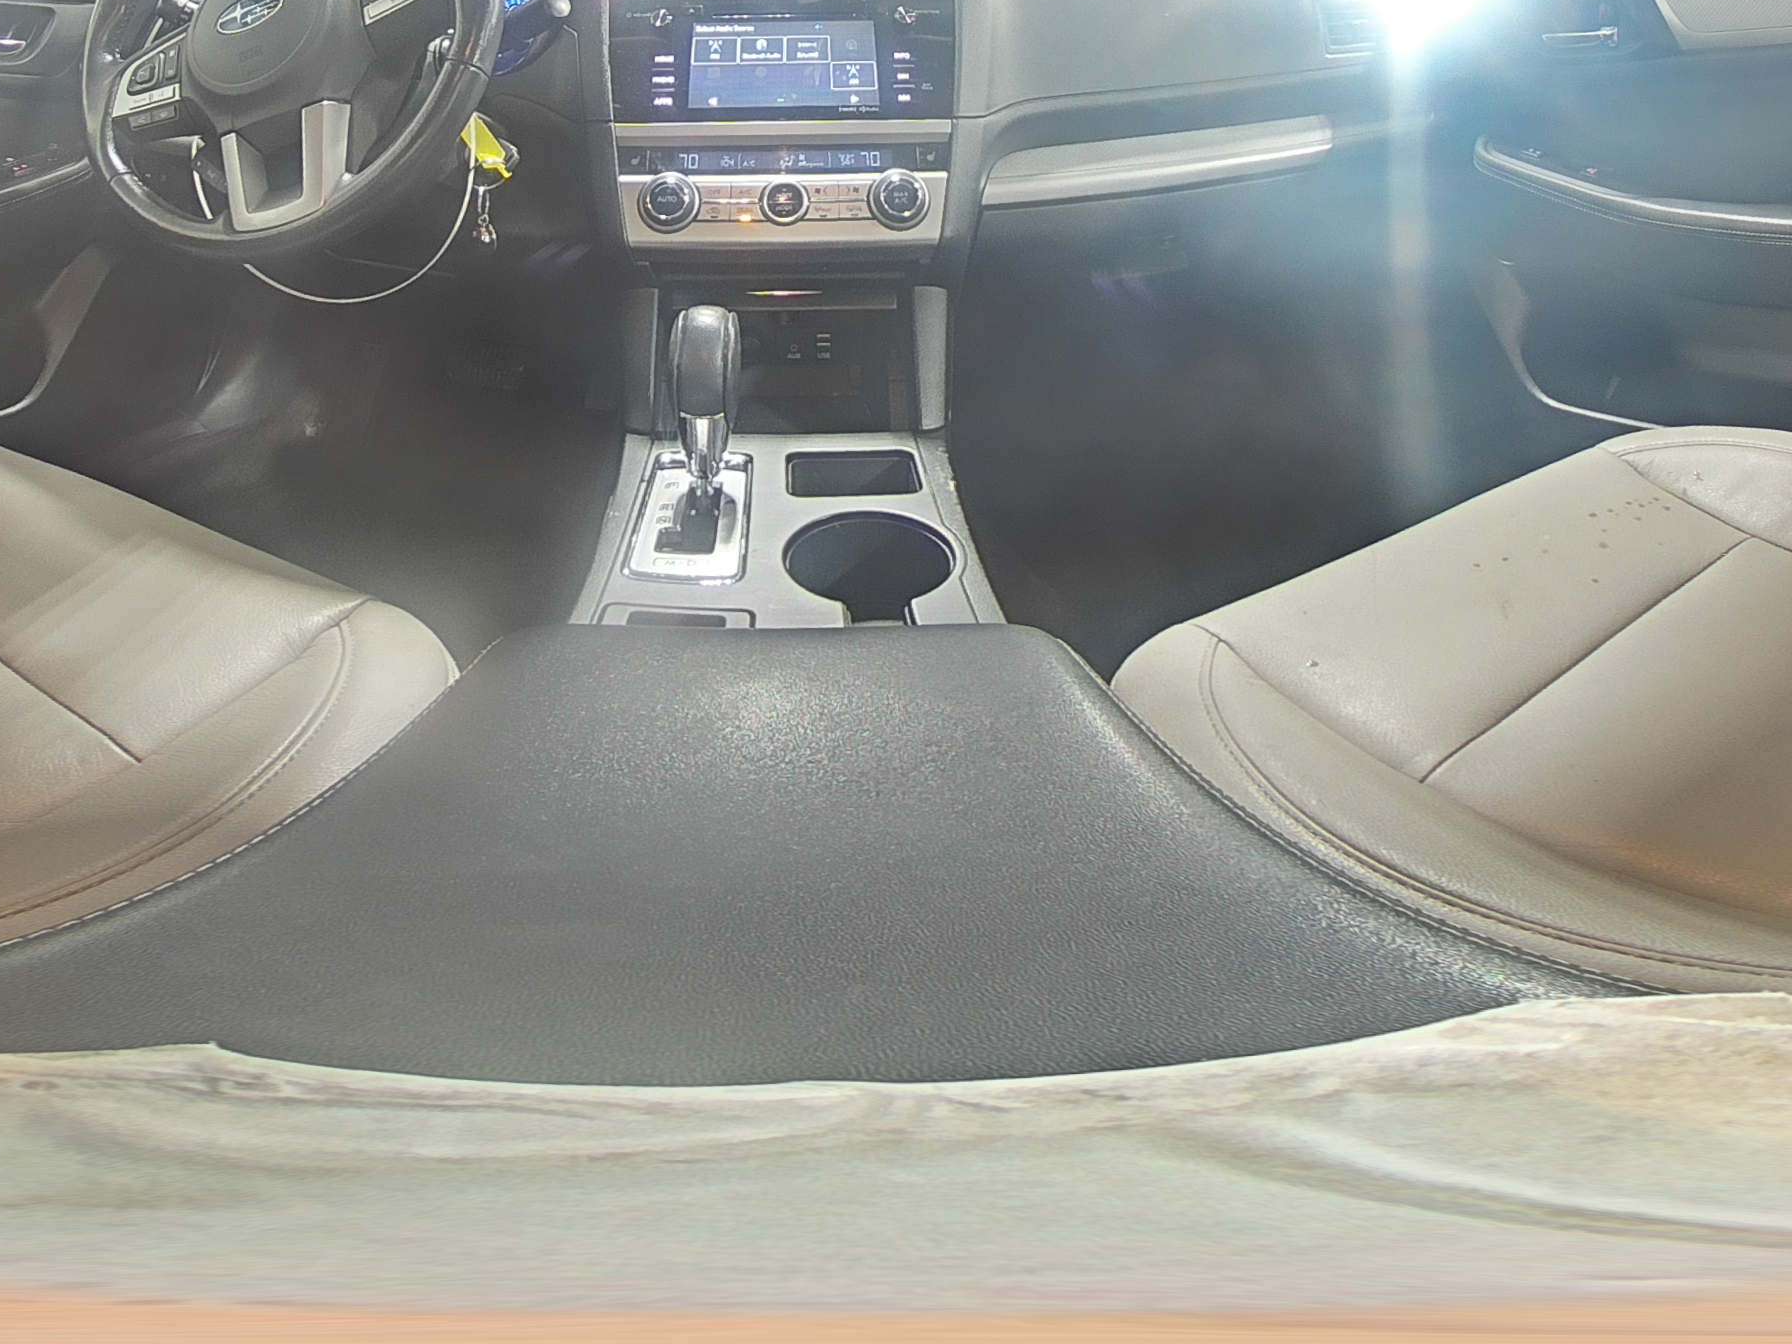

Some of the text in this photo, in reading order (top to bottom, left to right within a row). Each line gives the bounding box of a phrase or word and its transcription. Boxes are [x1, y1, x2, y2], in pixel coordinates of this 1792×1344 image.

[679, 153, 699, 169] 70
[860, 151, 880, 167] 70
[657, 195, 677, 203] AUTO
